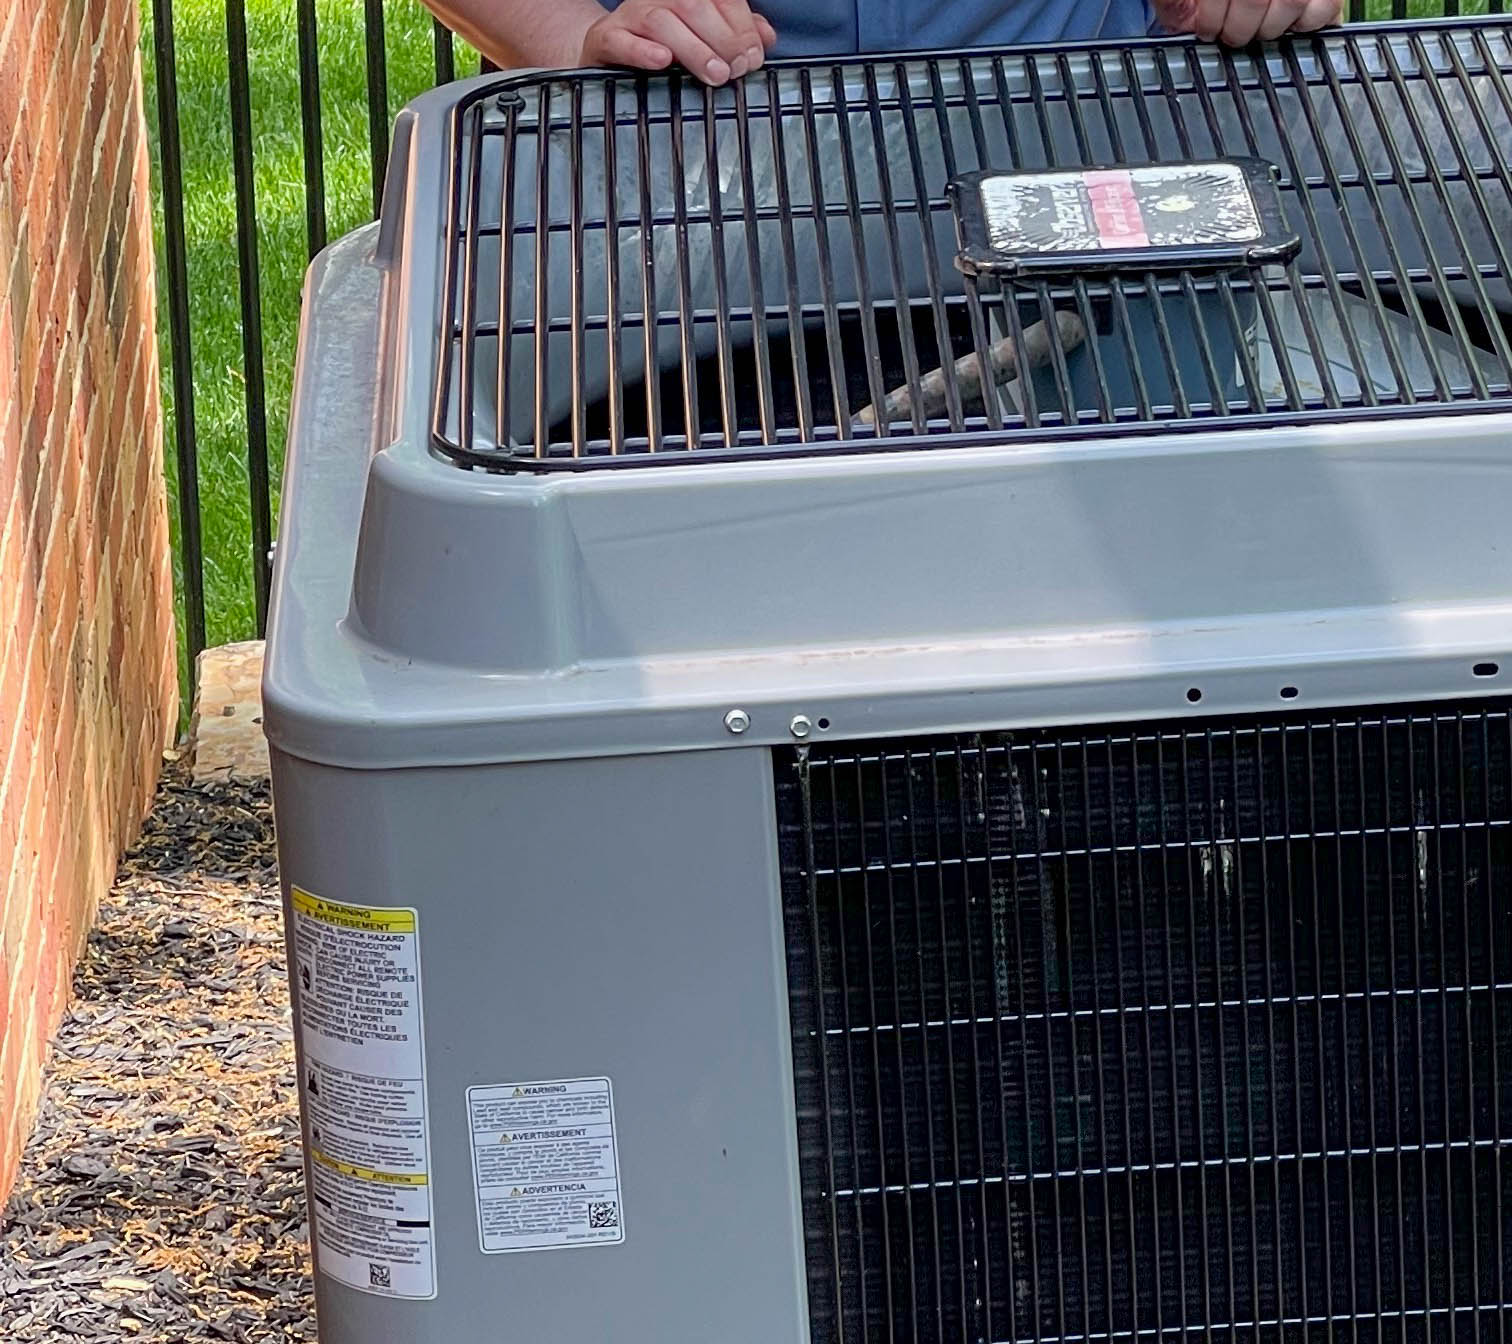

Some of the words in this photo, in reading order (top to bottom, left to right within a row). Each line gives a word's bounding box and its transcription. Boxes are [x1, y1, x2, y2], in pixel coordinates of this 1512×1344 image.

[328, 904, 371, 919] WARNING
[314, 912, 390, 931] AVERTISSEMENT
[368, 934, 405, 942] HAZARD
[523, 1085, 567, 1095] WARNING
[512, 1128, 587, 1141] AVERTISSEMENT
[523, 1183, 586, 1195] ADVERTENCIA
